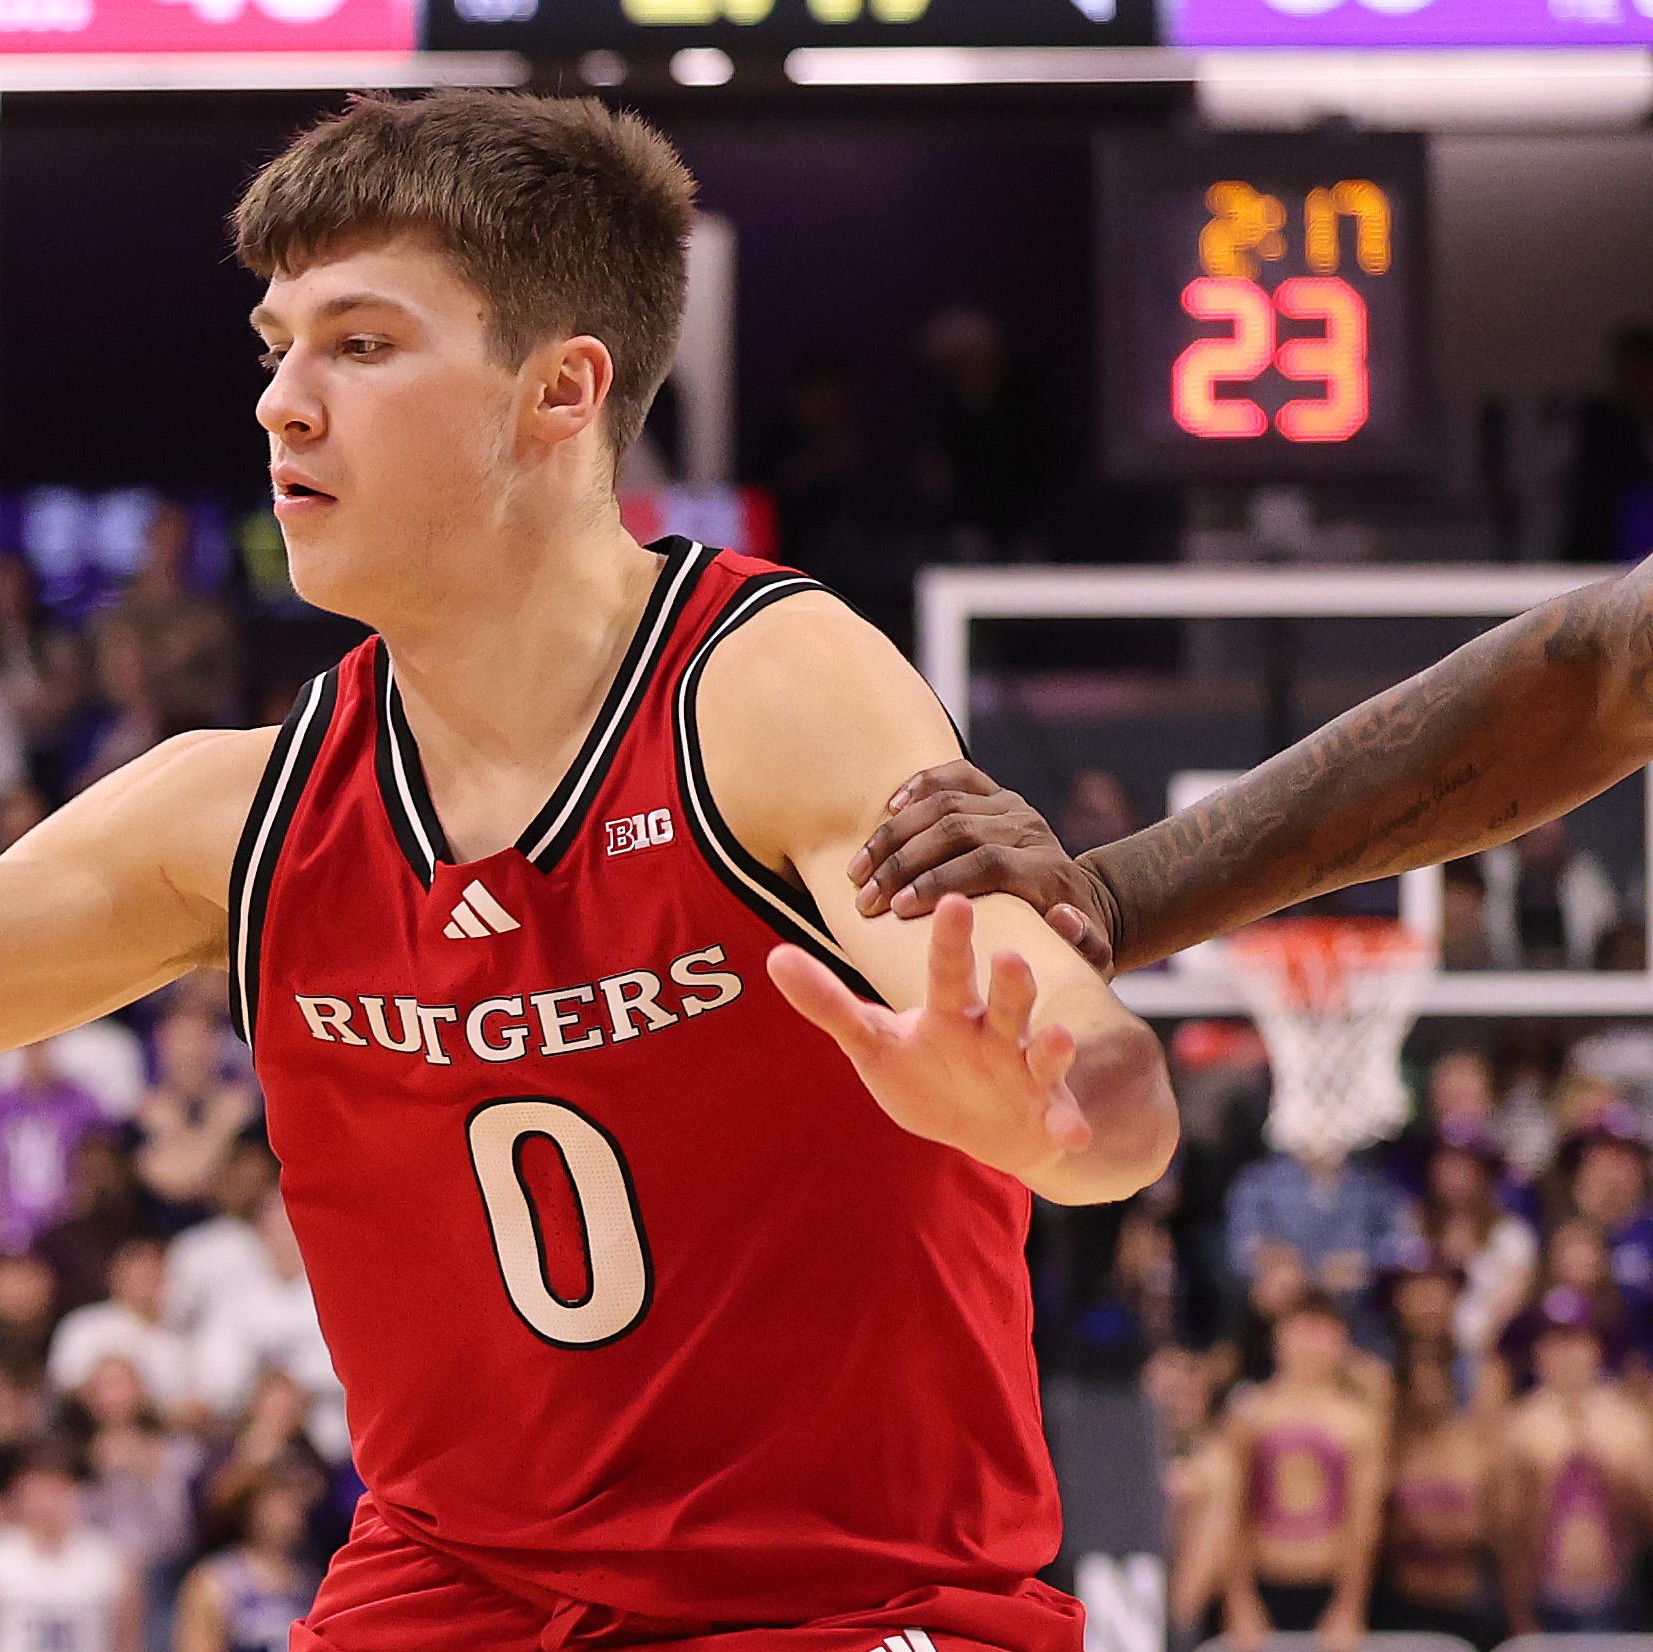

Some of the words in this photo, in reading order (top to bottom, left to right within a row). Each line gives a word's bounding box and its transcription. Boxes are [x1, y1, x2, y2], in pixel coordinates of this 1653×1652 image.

[1171, 277, 1371, 442] 23
[295, 945, 745, 1065] RUTGERS
[465, 1095, 655, 1351] 0
